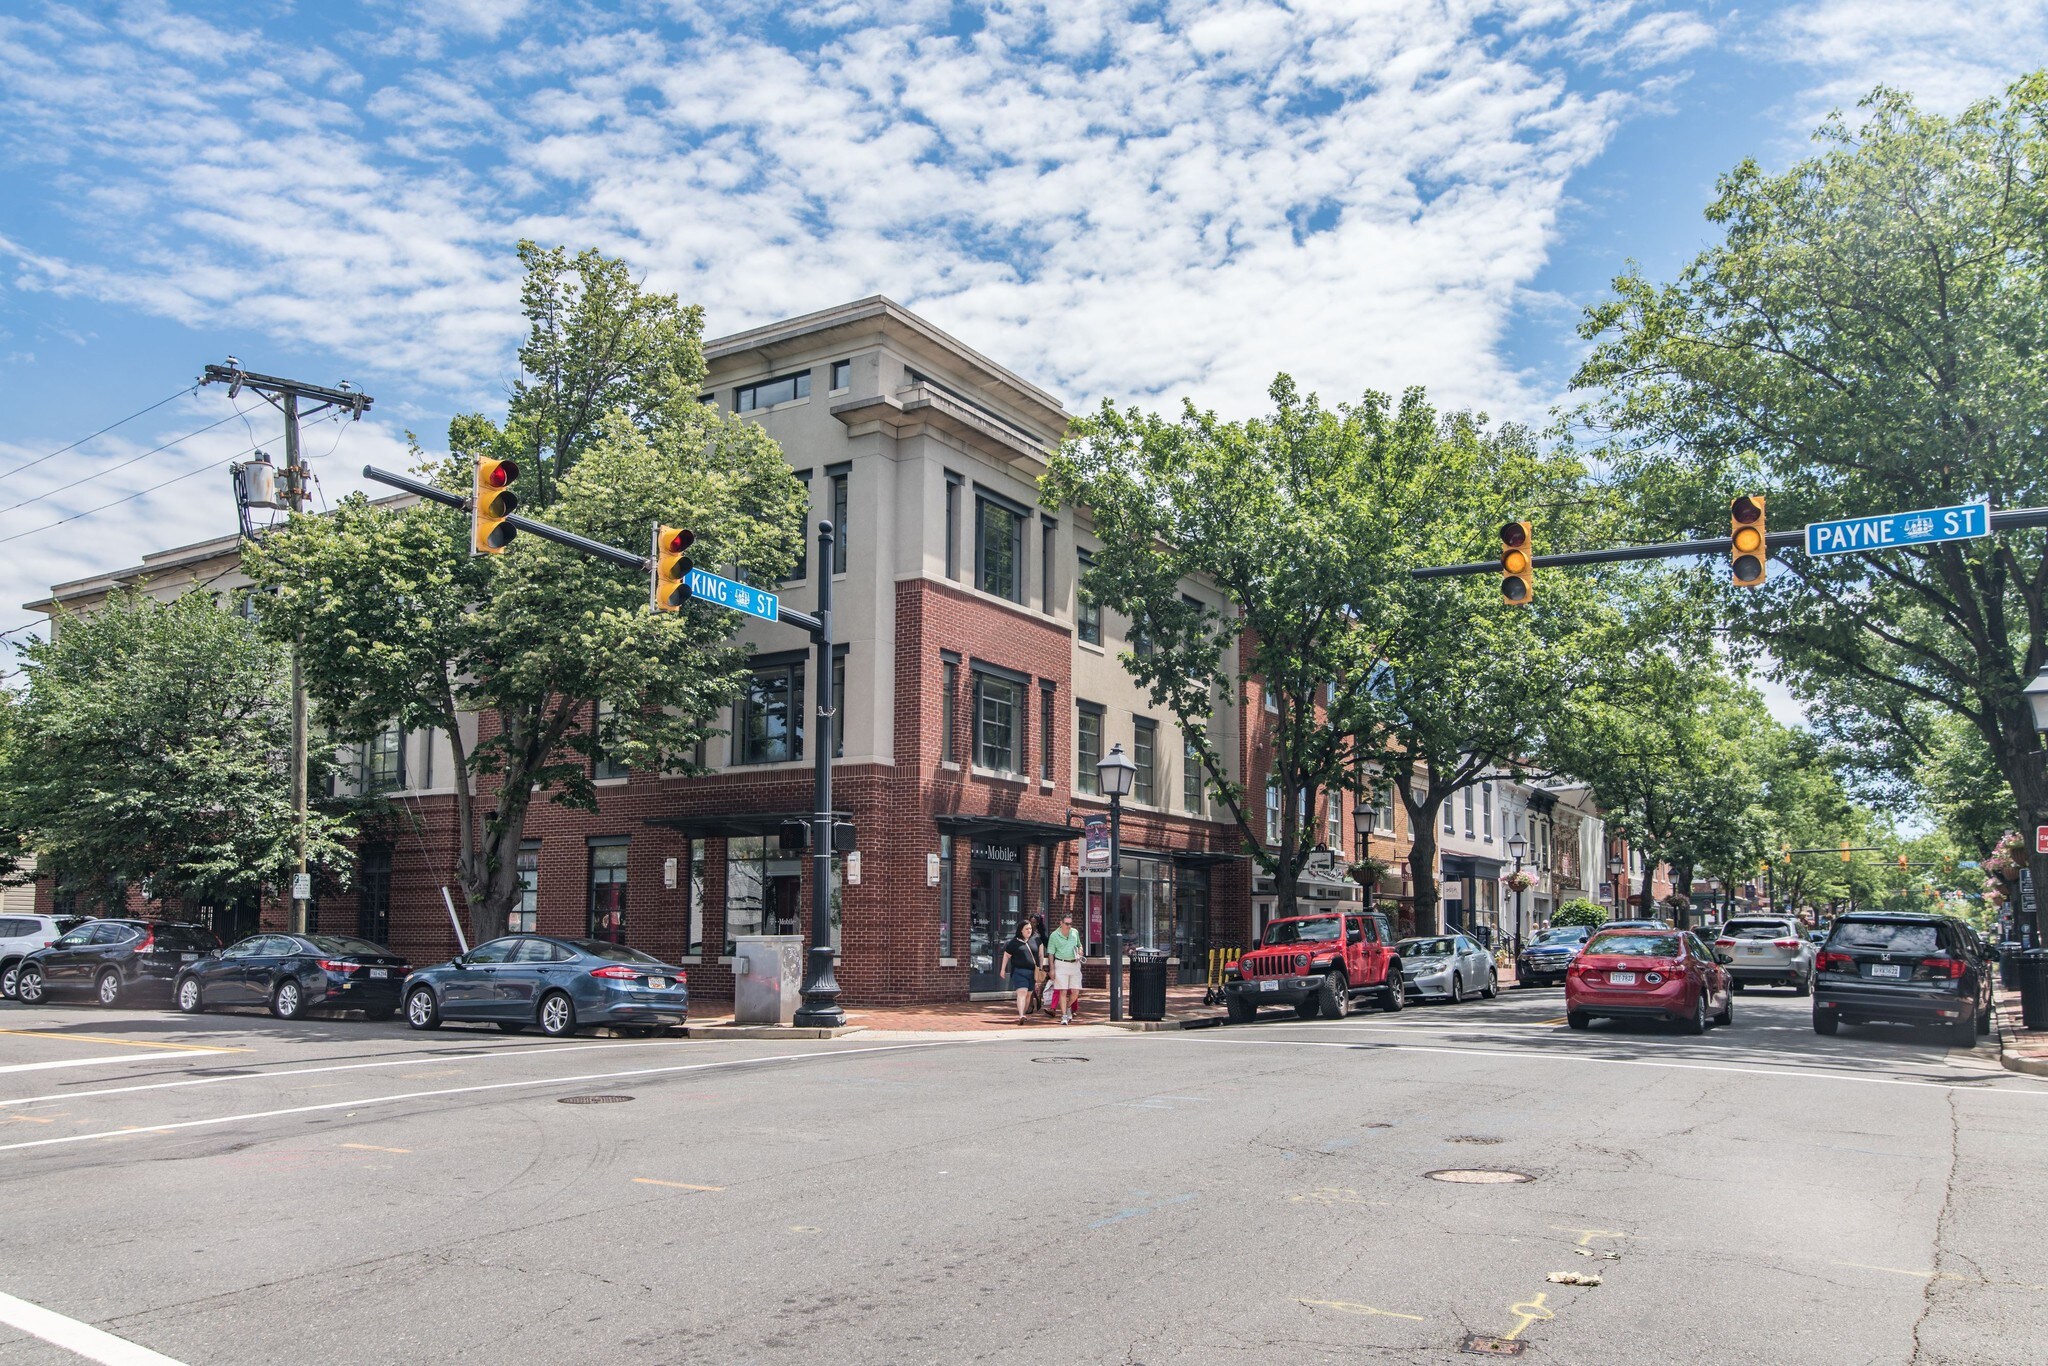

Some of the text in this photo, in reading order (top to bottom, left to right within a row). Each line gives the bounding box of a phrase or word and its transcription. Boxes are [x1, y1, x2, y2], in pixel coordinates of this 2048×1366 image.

[1816, 509, 1976, 550] PAYNE ST
[692, 572, 773, 616] KING ST
